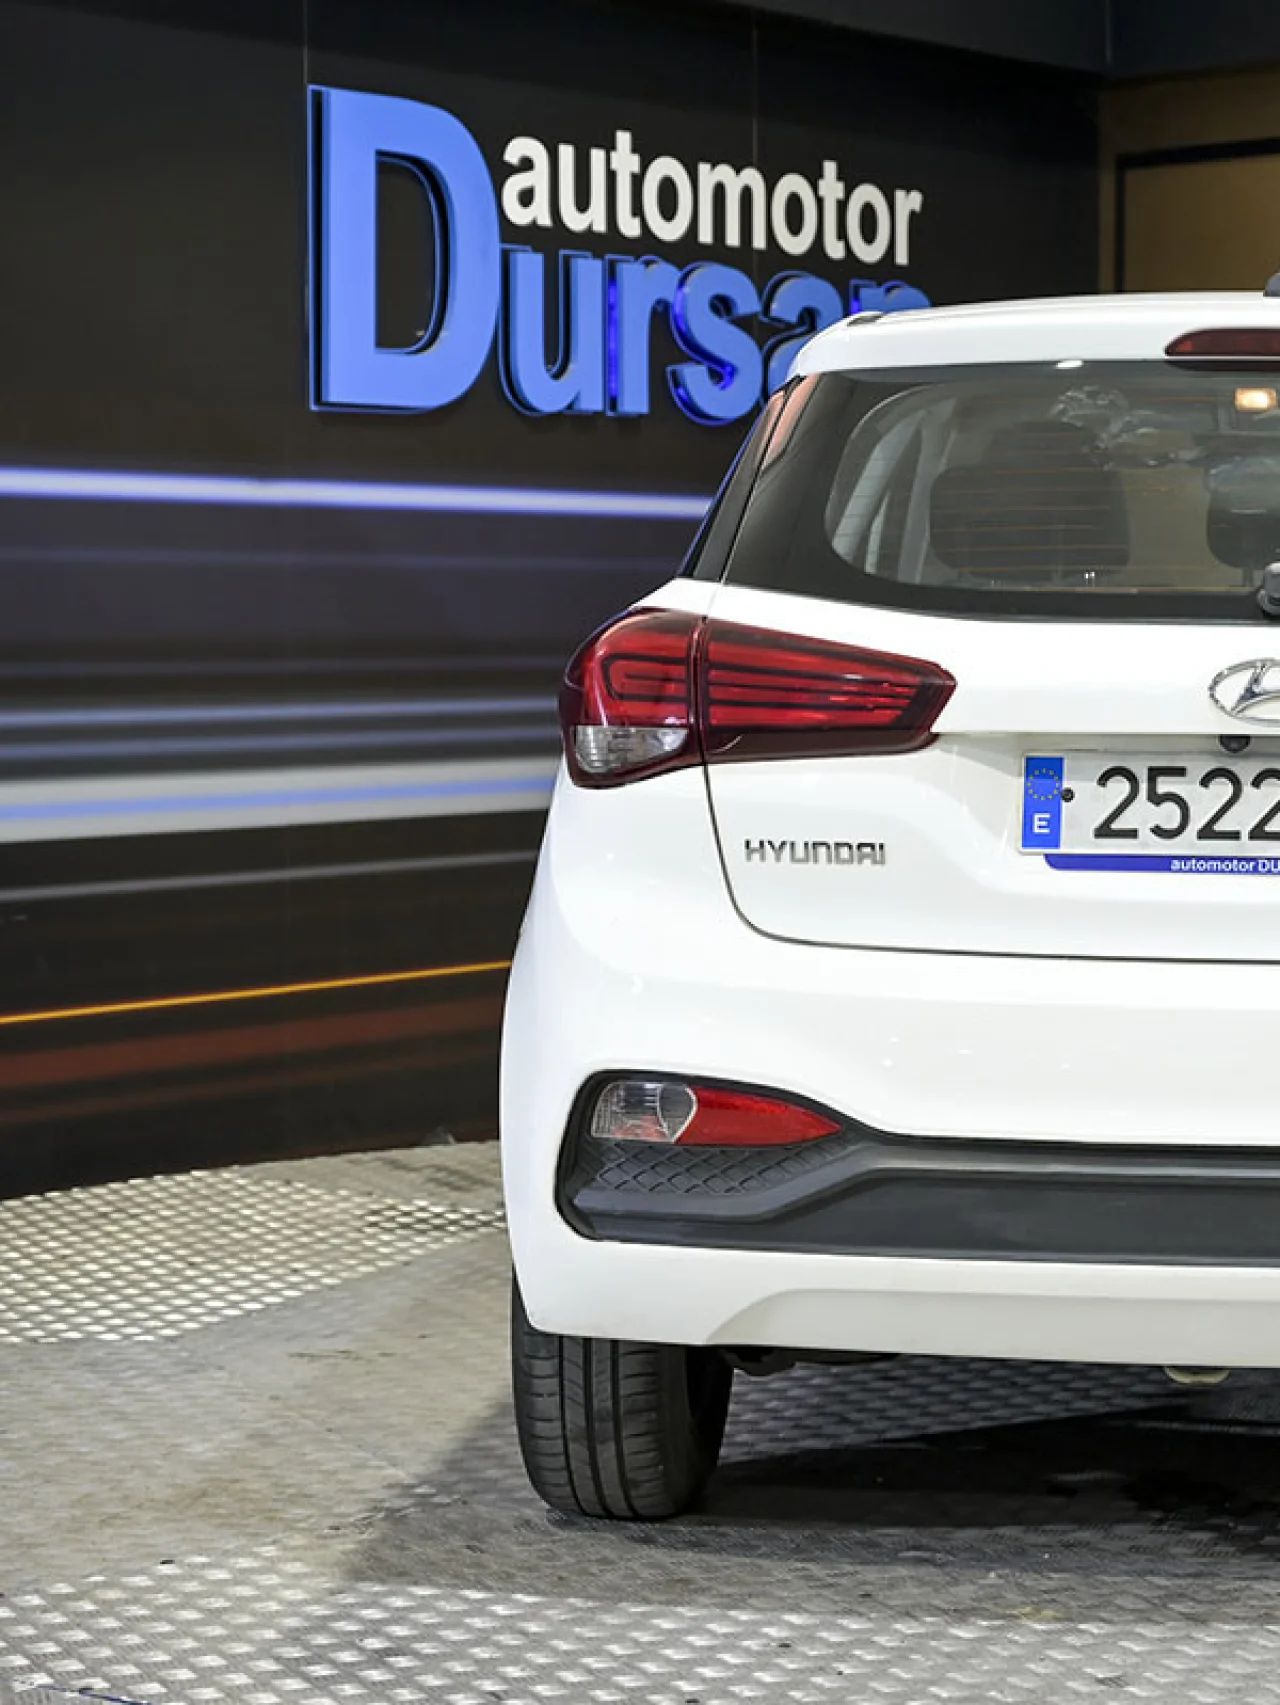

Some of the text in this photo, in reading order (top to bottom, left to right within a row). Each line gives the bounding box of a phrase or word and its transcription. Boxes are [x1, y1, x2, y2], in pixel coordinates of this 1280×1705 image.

[501, 130, 923, 265] automotor
[307, 85, 929, 427] Dursa
[744, 840, 885, 864] HYUNDAI
[1033, 814, 1050, 833] E
